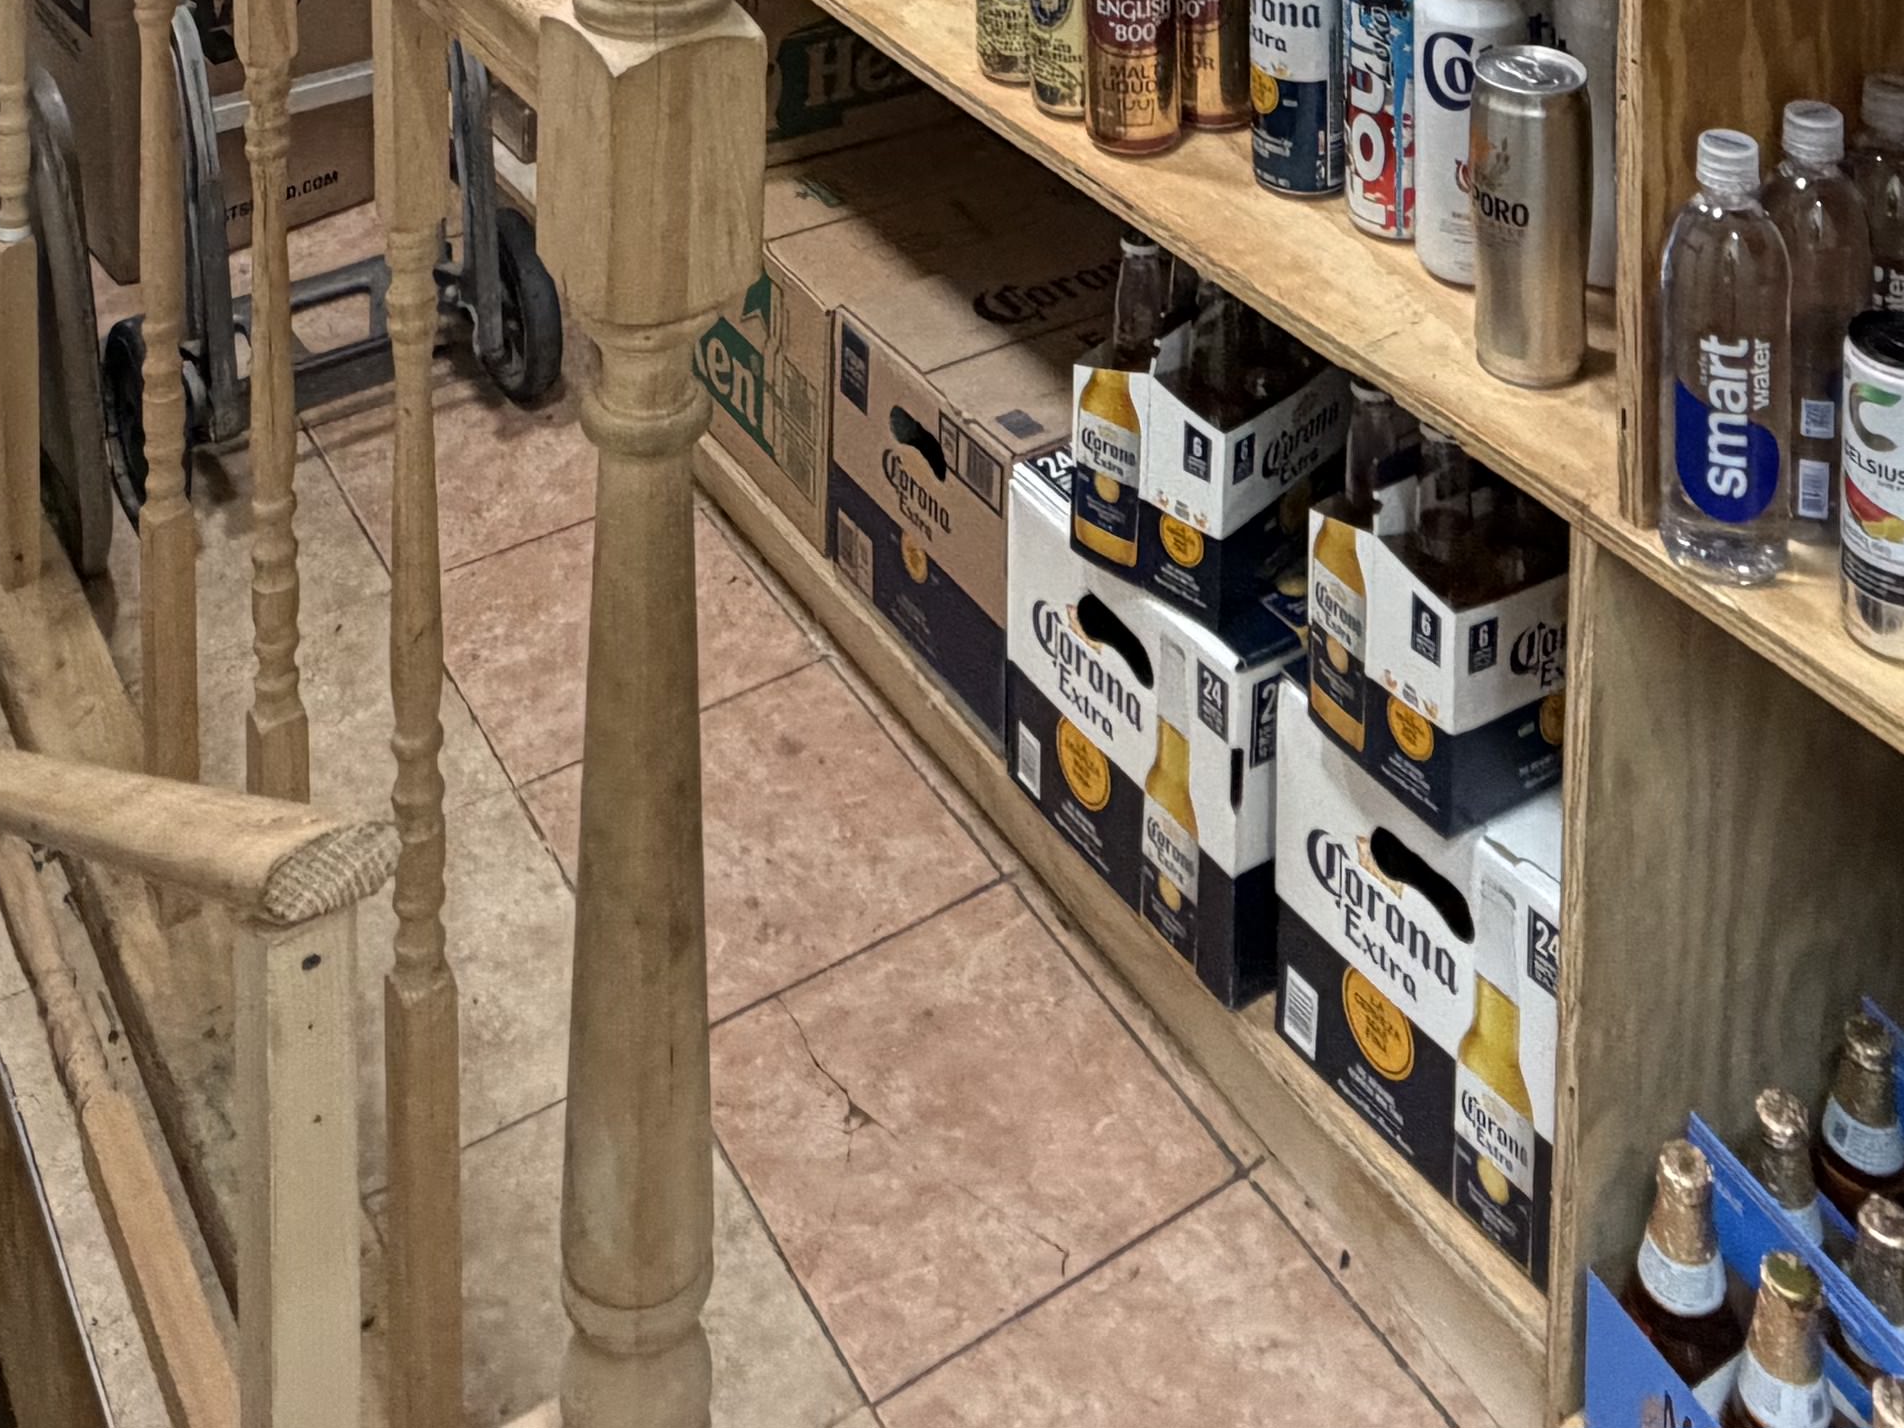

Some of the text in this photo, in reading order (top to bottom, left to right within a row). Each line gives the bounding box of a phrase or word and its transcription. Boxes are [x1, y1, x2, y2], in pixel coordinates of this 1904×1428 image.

[1752, 338, 1771, 411] water
[1262, 400, 1340, 481] Corona
[1700, 334, 1749, 500] smart
[1080, 427, 1137, 469] Corona
[1093, 453, 1124, 478] Extra
[1192, 435, 1203, 459] 6
[1240, 438, 1250, 460] 6
[883, 448, 953, 535] Corona
[898, 492, 934, 542] Extra
[1315, 582, 1362, 637] Corona
[1418, 609, 1432, 637] 6
[1478, 623, 1489, 646] 6
[1032, 599, 1143, 733] Corona
[1202, 675, 1223, 709] 24
[1052, 659, 1114, 741] Extra
[1147, 815, 1195, 875] Corona
[1306, 827, 1459, 996] Corona
[1336, 897, 1418, 1004] Extra
[1462, 1087, 1529, 1166] Corona
[1476, 1124, 1514, 1172] Extra
